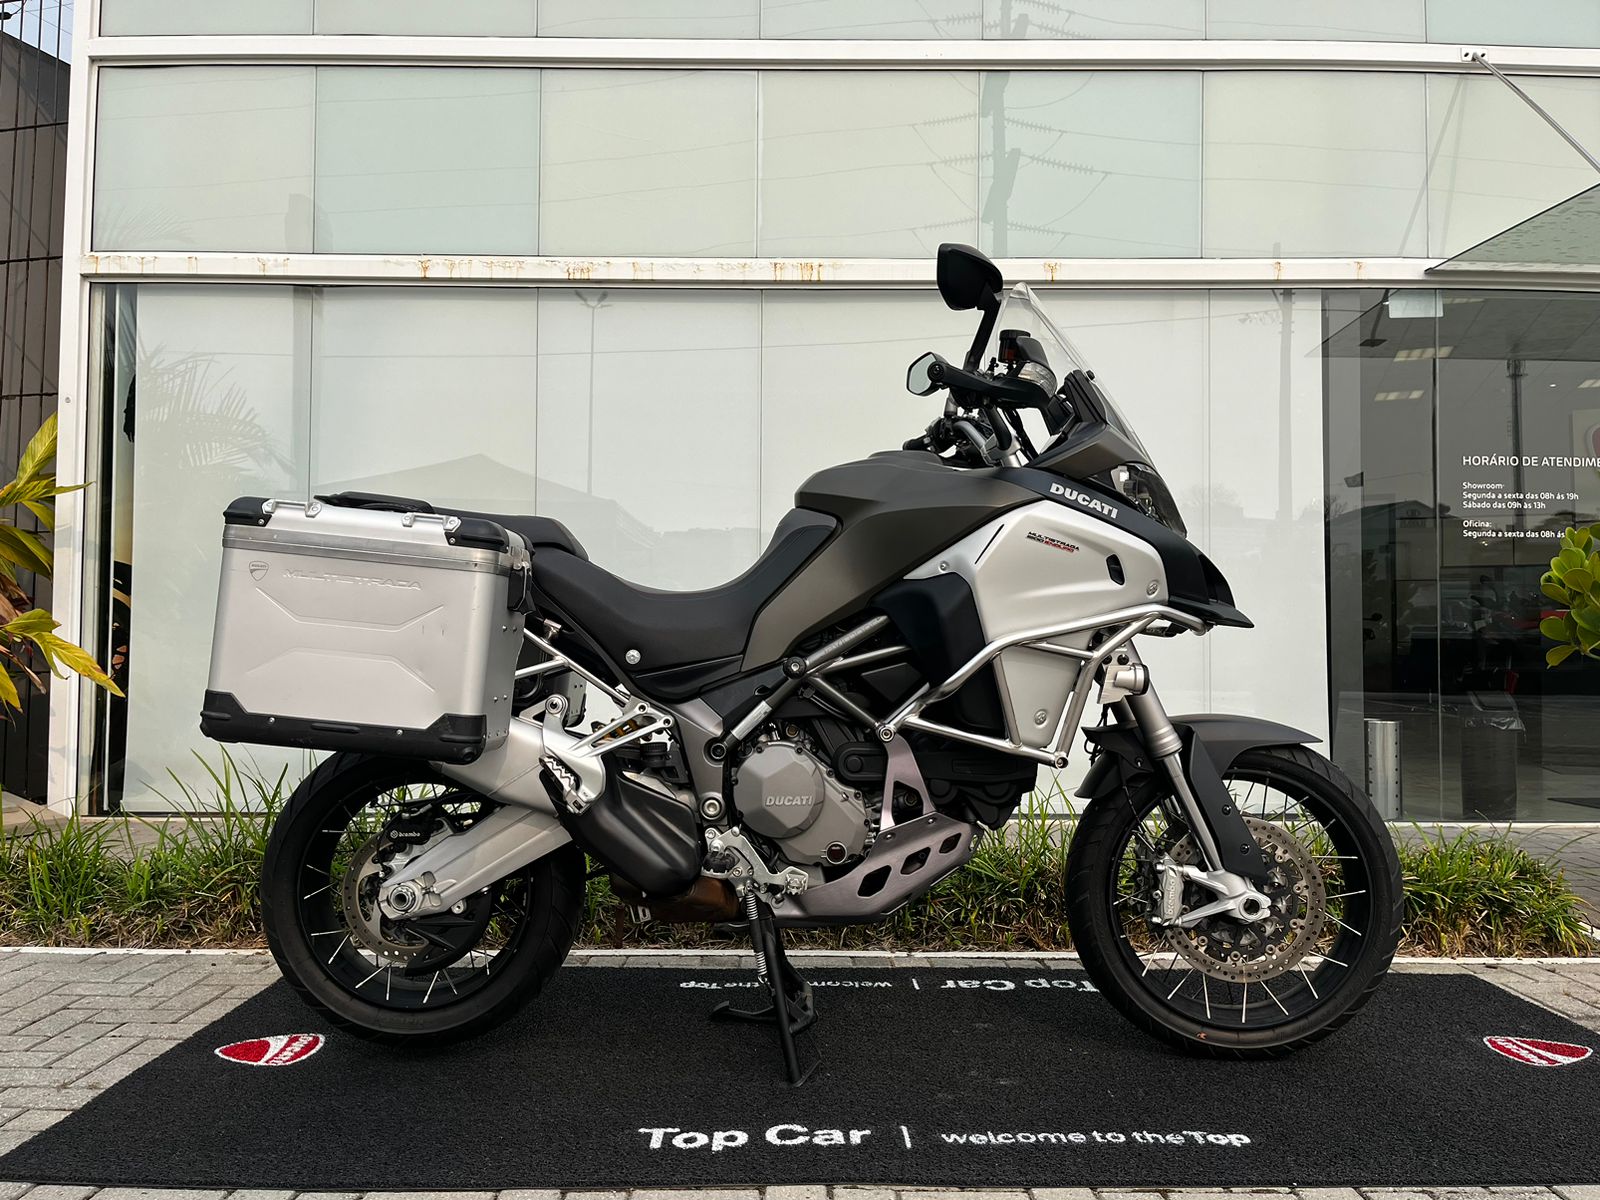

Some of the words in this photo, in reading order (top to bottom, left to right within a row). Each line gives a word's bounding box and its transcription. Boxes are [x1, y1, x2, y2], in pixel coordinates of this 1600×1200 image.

[1462, 453, 1519, 467] HORÁRIO
[1522, 456, 1539, 467] DE
[1049, 482, 1119, 519] DUCATI
[1462, 491, 1496, 501] Segunda
[1503, 492, 1524, 500] sexta
[1525, 491, 1539, 500] das
[1540, 492, 1555, 500] 08h
[1566, 492, 1579, 501] 19h
[1462, 500, 1491, 509] Sábado
[1492, 501, 1506, 509] das
[1507, 501, 1522, 509] 09h
[1533, 501, 1546, 509] 13h
[1462, 520, 1493, 528] Oficina:
[1462, 529, 1496, 539] Segunda
[1504, 530, 1524, 538] sexta
[1525, 530, 1539, 539] das
[1540, 530, 1555, 538] 08h
[1028, 531, 1080, 551] MULTISTRADA
[765, 795, 813, 806] DUCATI
[1165, 880, 1176, 915] brembo
[679, 980, 723, 989] Top
[940, 979, 1016, 991] Car
[1024, 978, 1100, 992] Top
[638, 1127, 749, 1154] Top
[765, 1123, 872, 1146] Car
[940, 1130, 1087, 1145] welcome
[1092, 1130, 1127, 1144] to
[1131, 1130, 1185, 1145] the
[1182, 1129, 1251, 1147] Top
